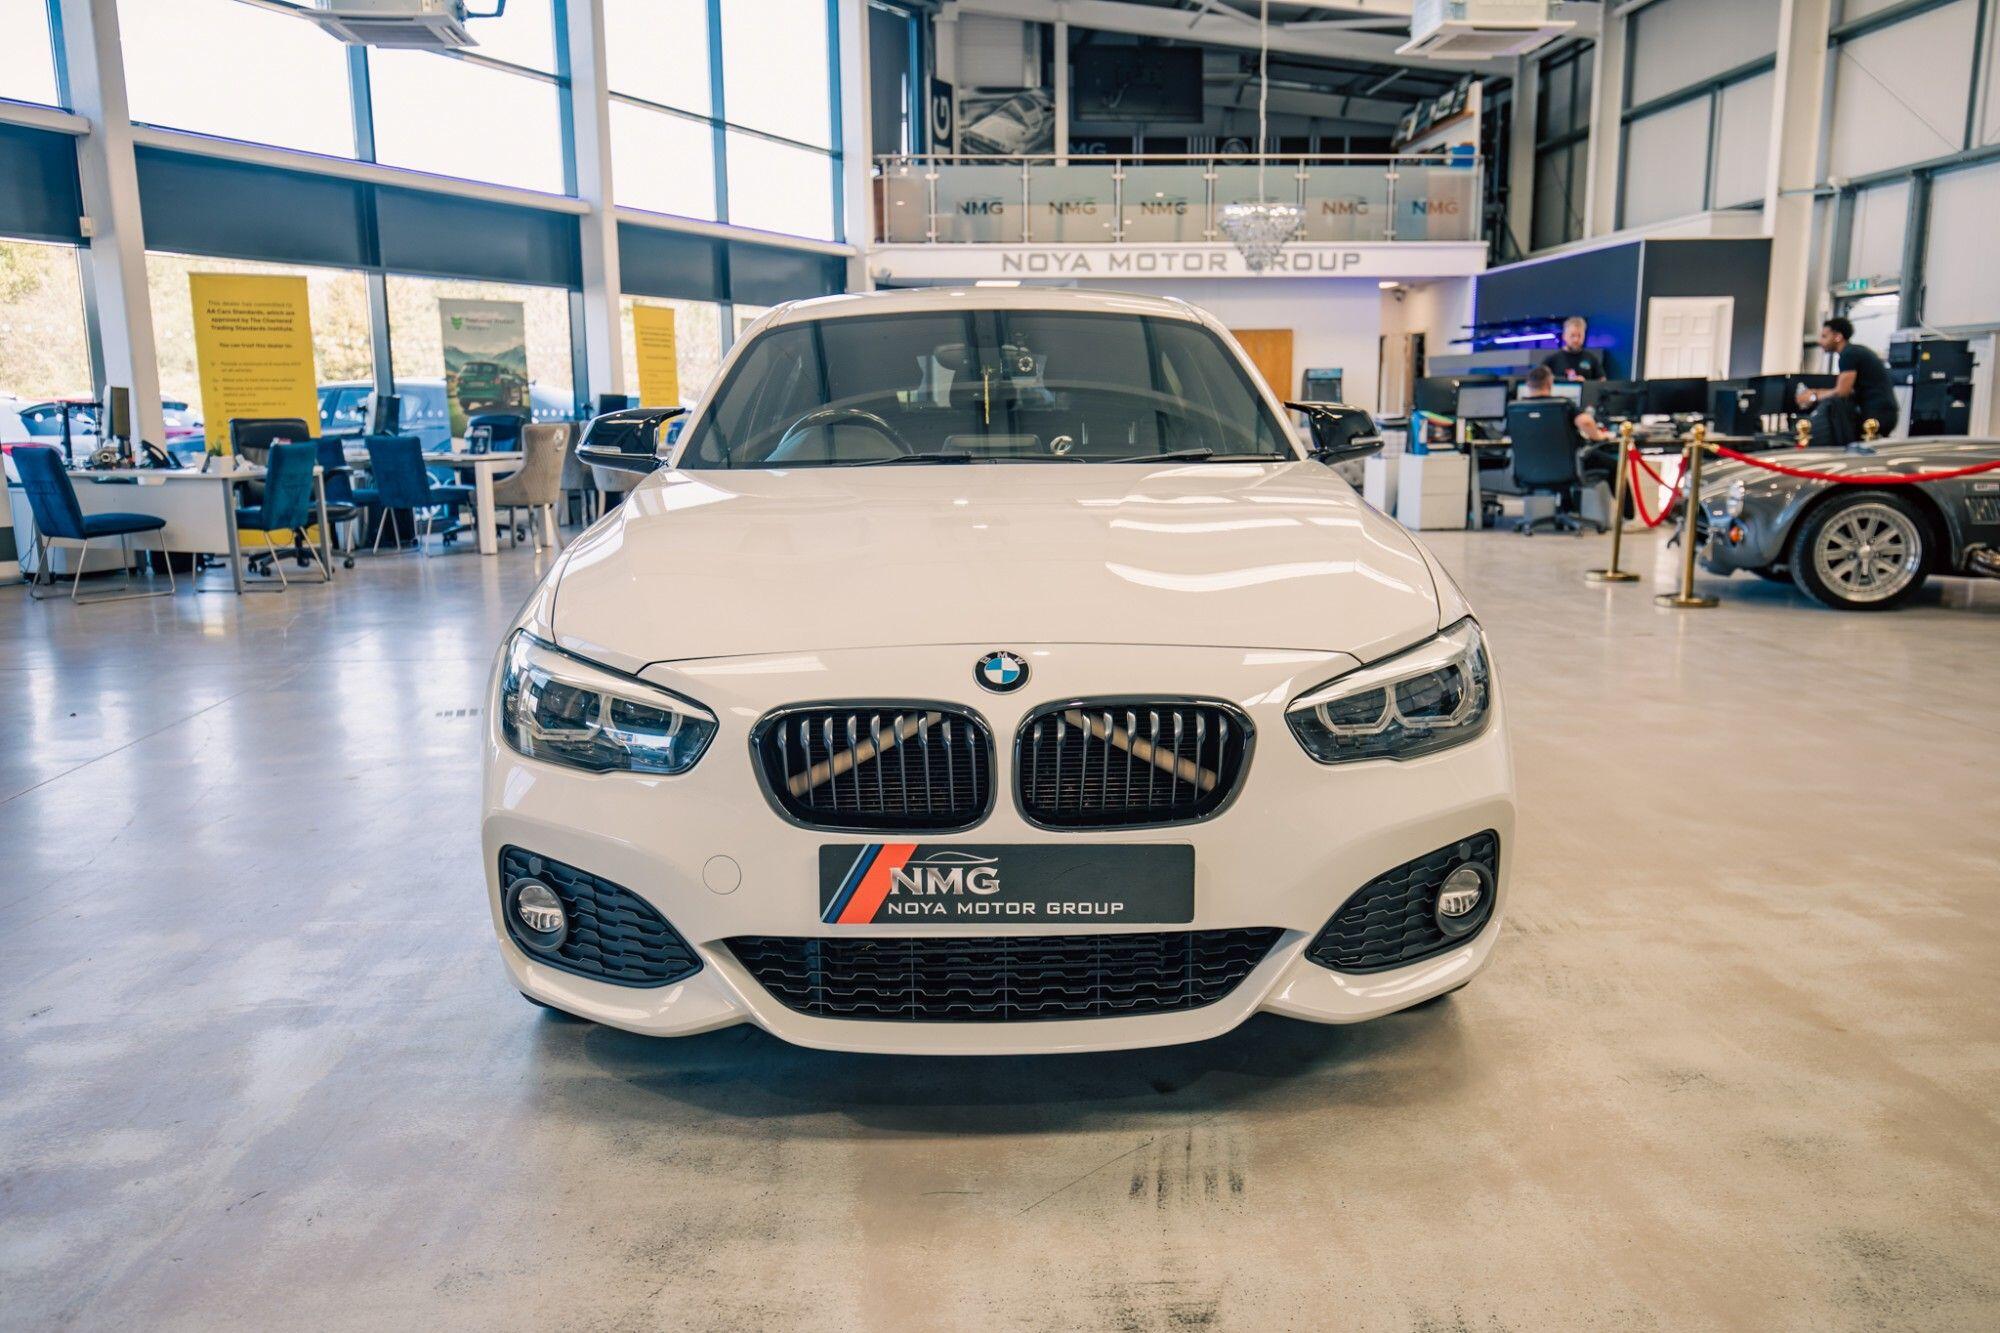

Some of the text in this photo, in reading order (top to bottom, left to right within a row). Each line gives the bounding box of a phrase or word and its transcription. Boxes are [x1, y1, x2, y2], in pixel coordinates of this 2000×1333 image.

[957, 202, 1004, 215] NMG
[1050, 202, 1097, 215] NMG
[1140, 202, 1188, 215] NMG
[1322, 201, 1369, 215] NMG
[1412, 201, 1459, 215] NMG
[1002, 253, 1362, 272] NOYA MOTOR ROUP
[980, 651, 1026, 664] BMW
[890, 867, 999, 895] NMG
[888, 902, 1124, 915] NOYA MOTOR GROUP
